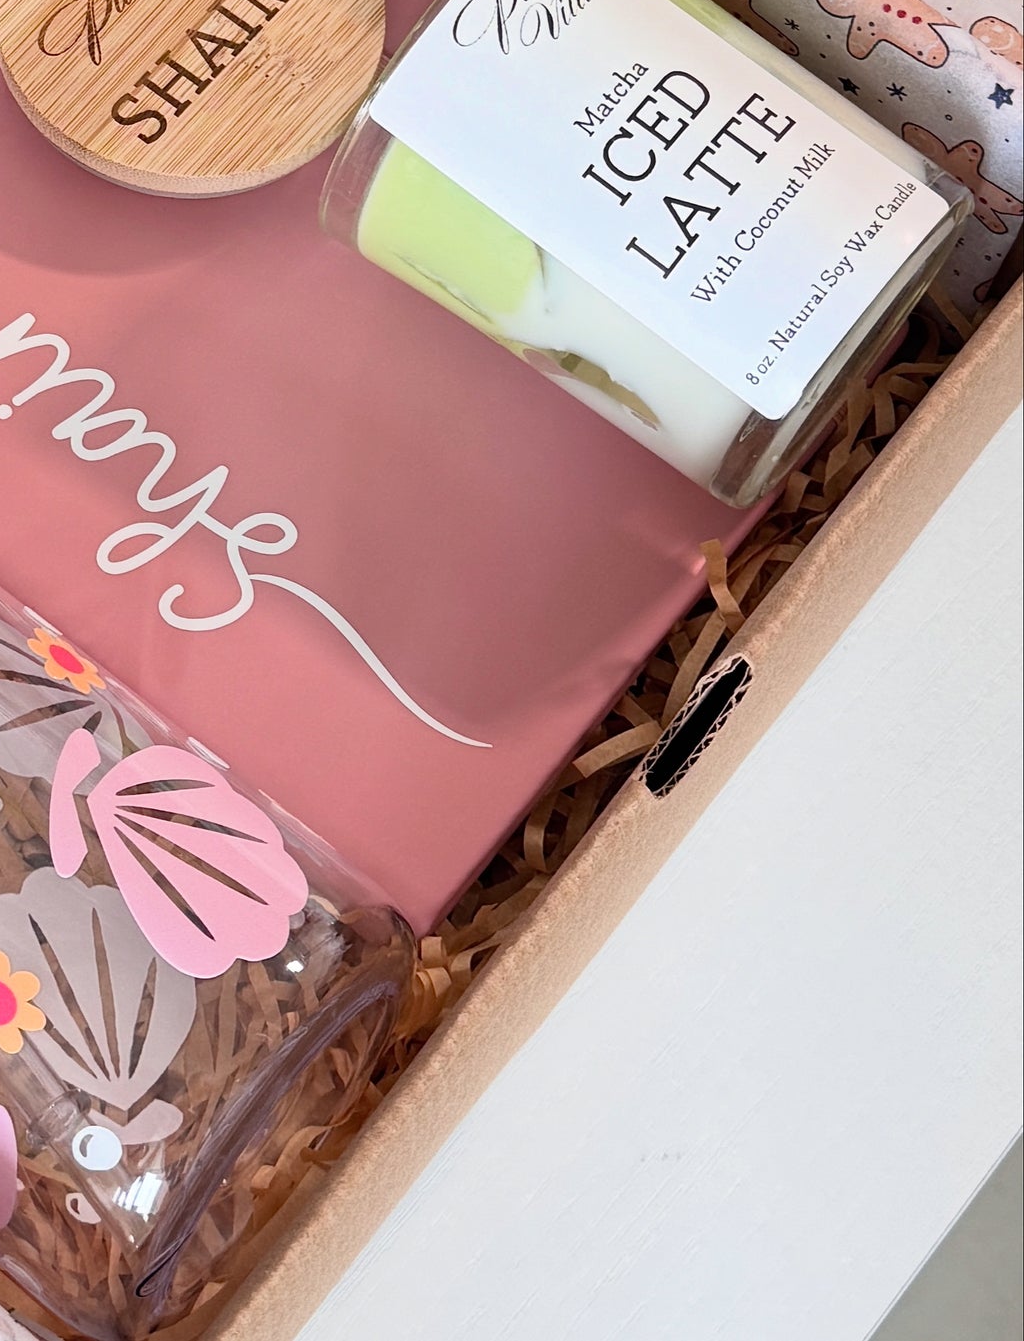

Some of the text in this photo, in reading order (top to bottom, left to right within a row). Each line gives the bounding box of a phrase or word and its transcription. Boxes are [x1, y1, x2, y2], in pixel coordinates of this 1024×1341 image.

[573, 61, 650, 137] Matcha
[582, 70, 711, 207] ICED
[625, 93, 797, 279] LATTE
[691, 142, 836, 304] With Coconut Milk
[745, 181, 917, 385] 8 oz. Natural Soy Wax Candle
